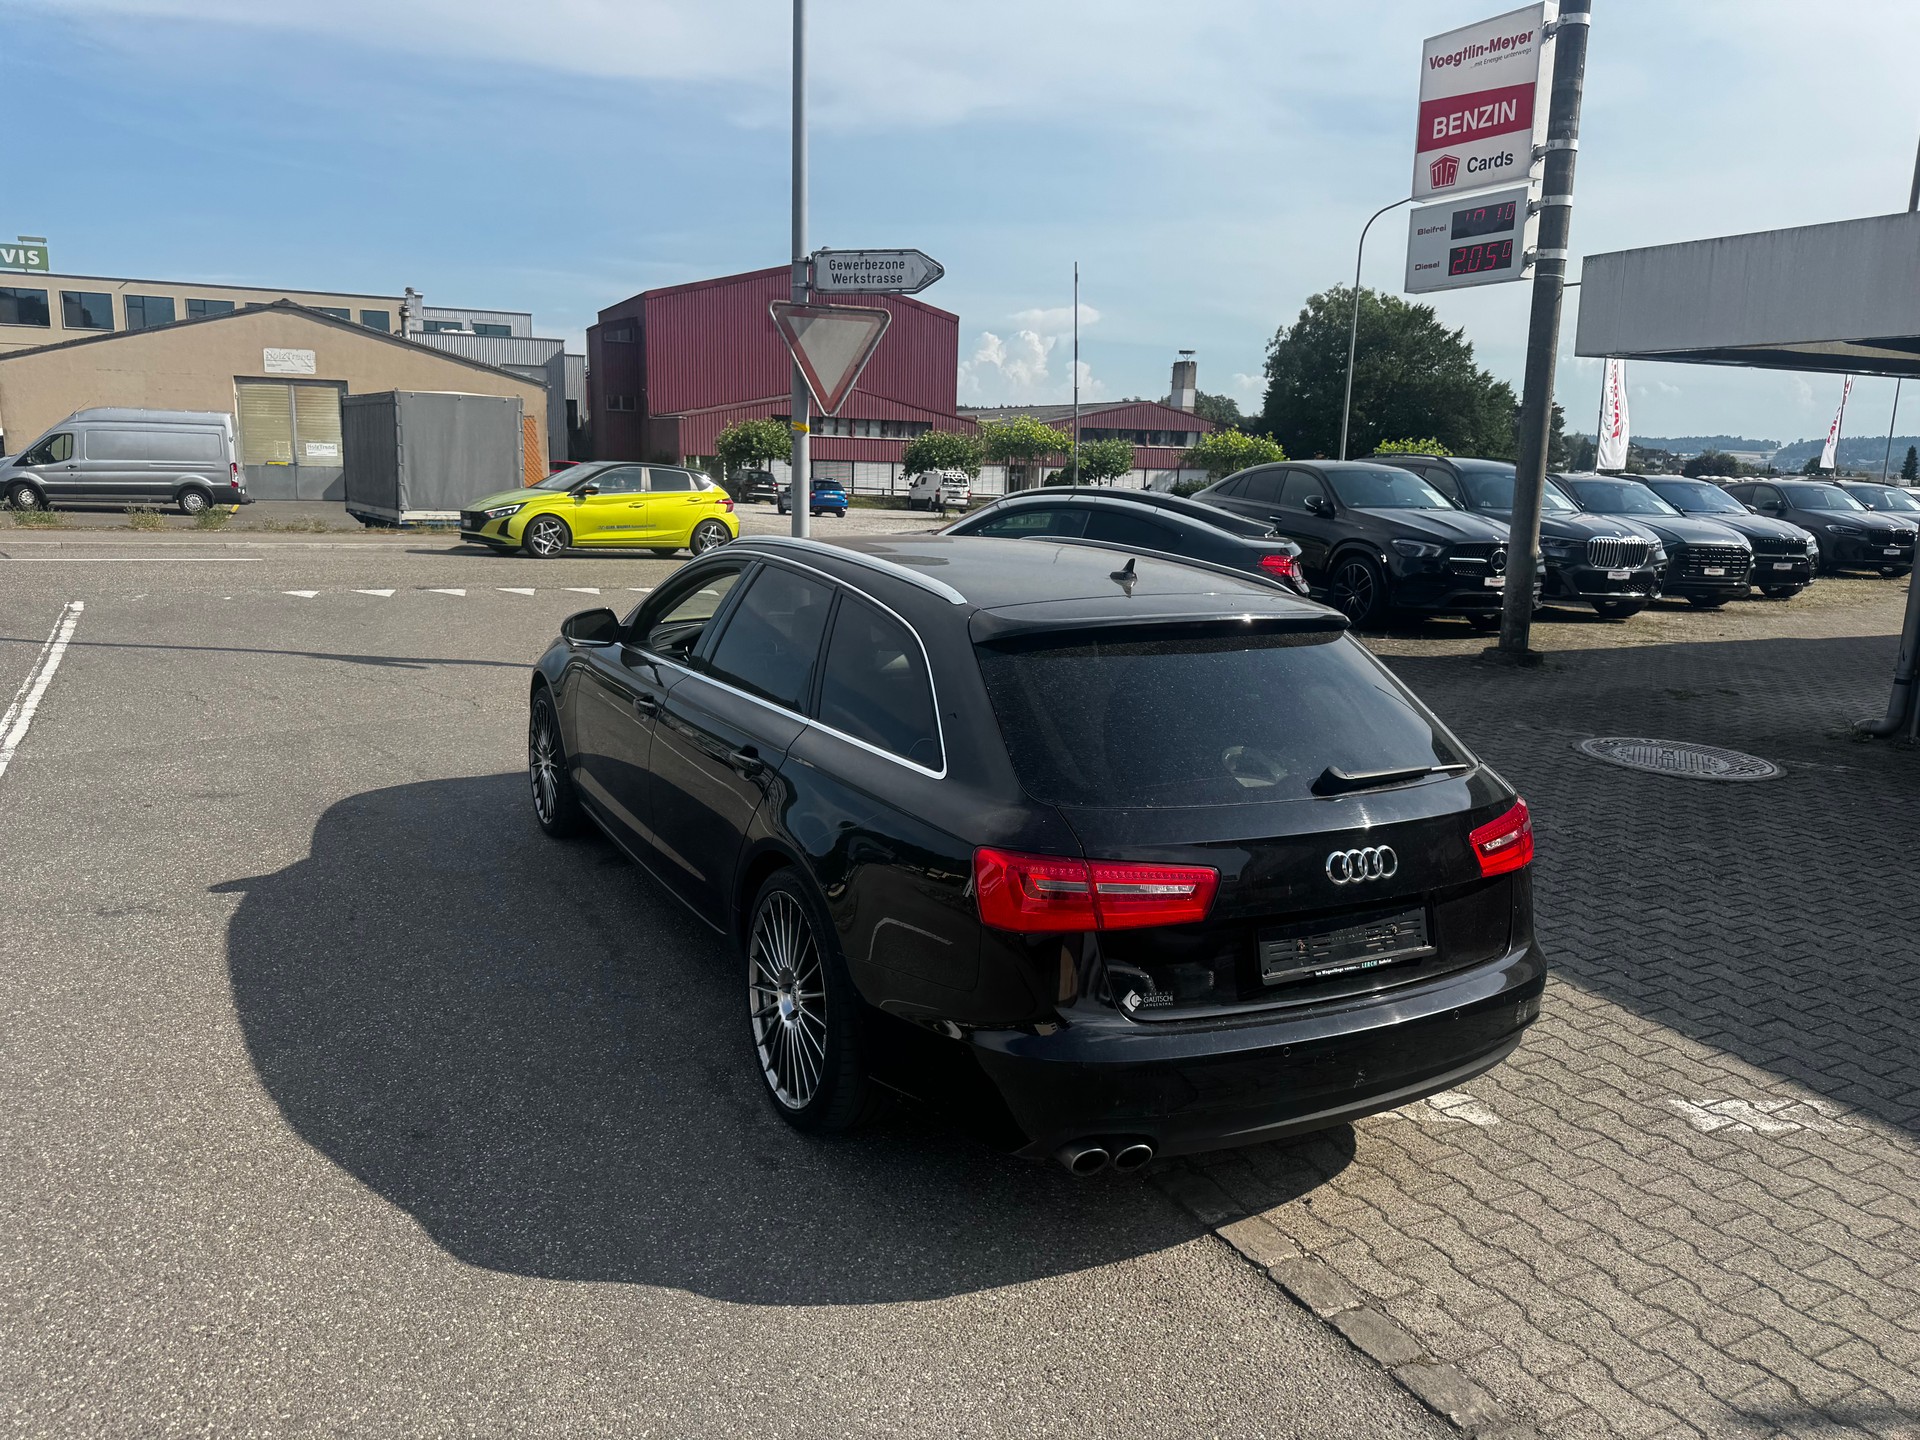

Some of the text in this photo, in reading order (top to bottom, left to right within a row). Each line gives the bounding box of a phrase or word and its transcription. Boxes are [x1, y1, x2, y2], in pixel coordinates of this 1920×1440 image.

[1429, 30, 1534, 70] Voegtlin-Meyer
[1483, 55, 1503, 65] Energie
[1504, 47, 1532, 60] unterwegs
[1432, 98, 1517, 140] BENZIN
[1467, 151, 1514, 173] Cards
[1417, 224, 1447, 236] Bleifrei
[829, 259, 905, 271] Gewerbezone
[1415, 261, 1440, 271] Diesel
[832, 273, 903, 284] Werkstrasse
[1361, 960, 1378, 968] LERCH
[1143, 995, 1173, 1003] GAUTSCHI
